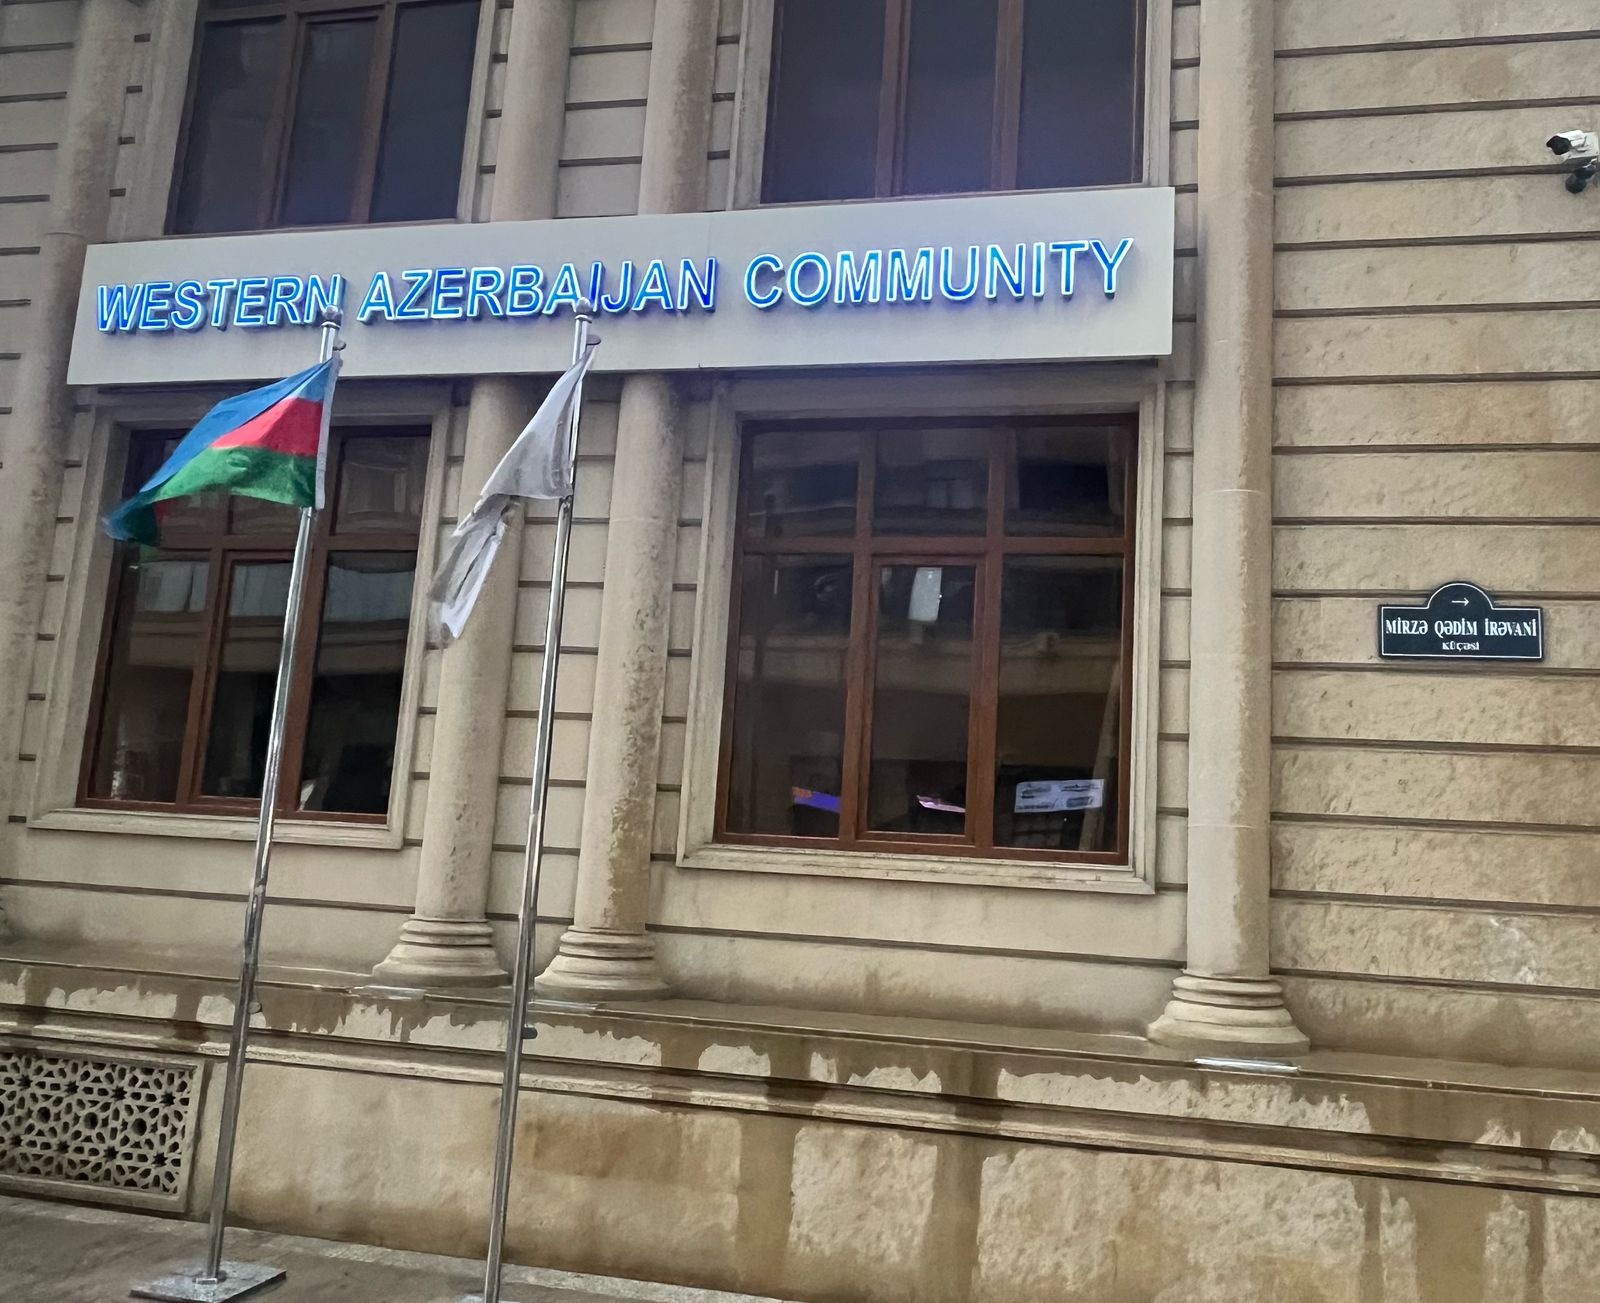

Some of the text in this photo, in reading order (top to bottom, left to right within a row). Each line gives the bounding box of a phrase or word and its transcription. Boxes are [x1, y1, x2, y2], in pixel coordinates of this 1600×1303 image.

[96, 237, 1134, 332] WESTERN AZERBAIJAN COMMUNITY
[1385, 617, 1537, 638] MİRZƏ QƏDİM İRƏVANİ
